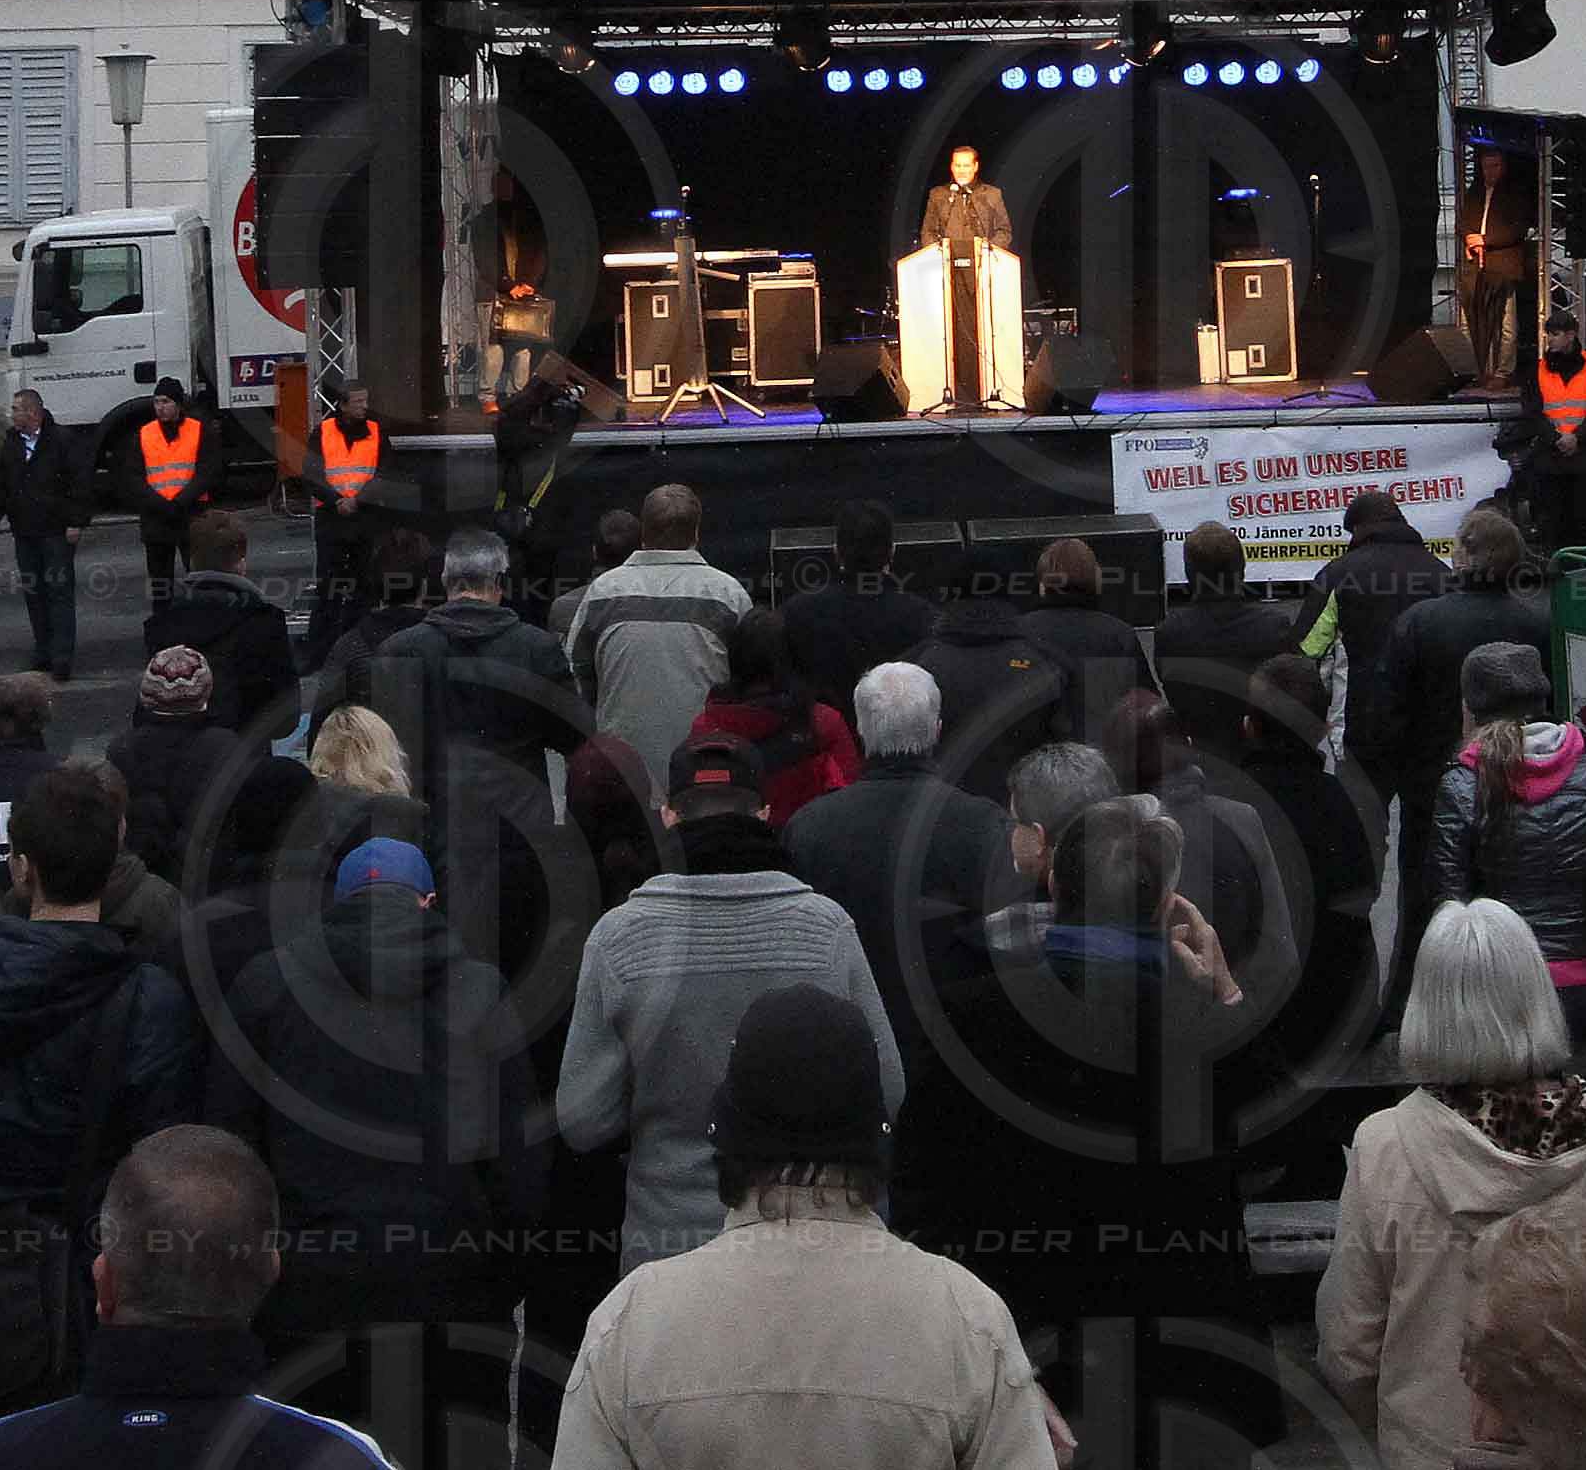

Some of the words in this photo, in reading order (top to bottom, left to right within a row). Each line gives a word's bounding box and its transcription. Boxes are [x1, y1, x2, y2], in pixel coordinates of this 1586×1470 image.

[1145, 465, 1211, 491] WEIL
[1216, 459, 1248, 486] ES
[1255, 455, 1299, 481] UM
[1306, 446, 1407, 477] UNSERE
[1229, 483, 1380, 519] SICHERHE
[1388, 474, 1466, 505] GEHT!
[1255, 525, 1303, 540] Jänner
[1309, 524, 1342, 538] 2013
[1245, 543, 1350, 559] WEHRPFLICHT
